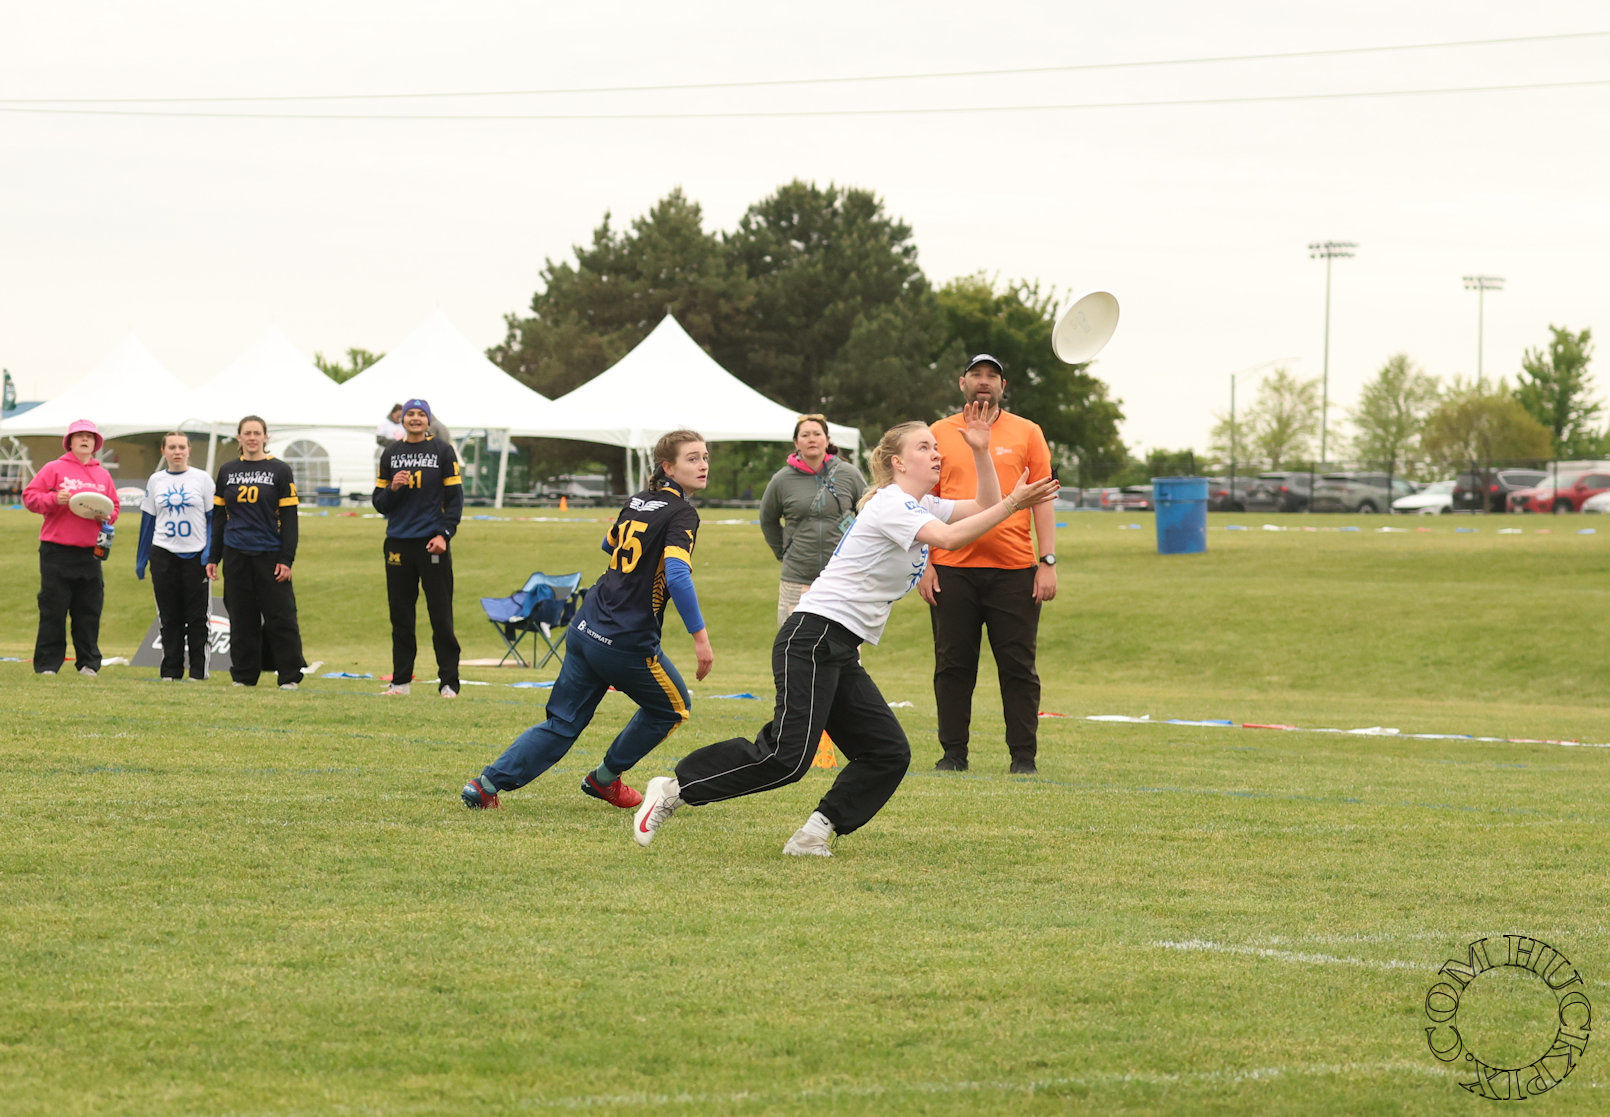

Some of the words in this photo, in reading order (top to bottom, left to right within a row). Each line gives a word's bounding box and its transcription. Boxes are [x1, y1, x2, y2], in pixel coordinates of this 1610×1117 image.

[391, 459, 439, 468] FLYWHEEL
[236, 485, 259, 504] 20
[164, 520, 192, 538] 30
[609, 519, 649, 574] 15
[586, 628, 613, 646] ULTIMATE
